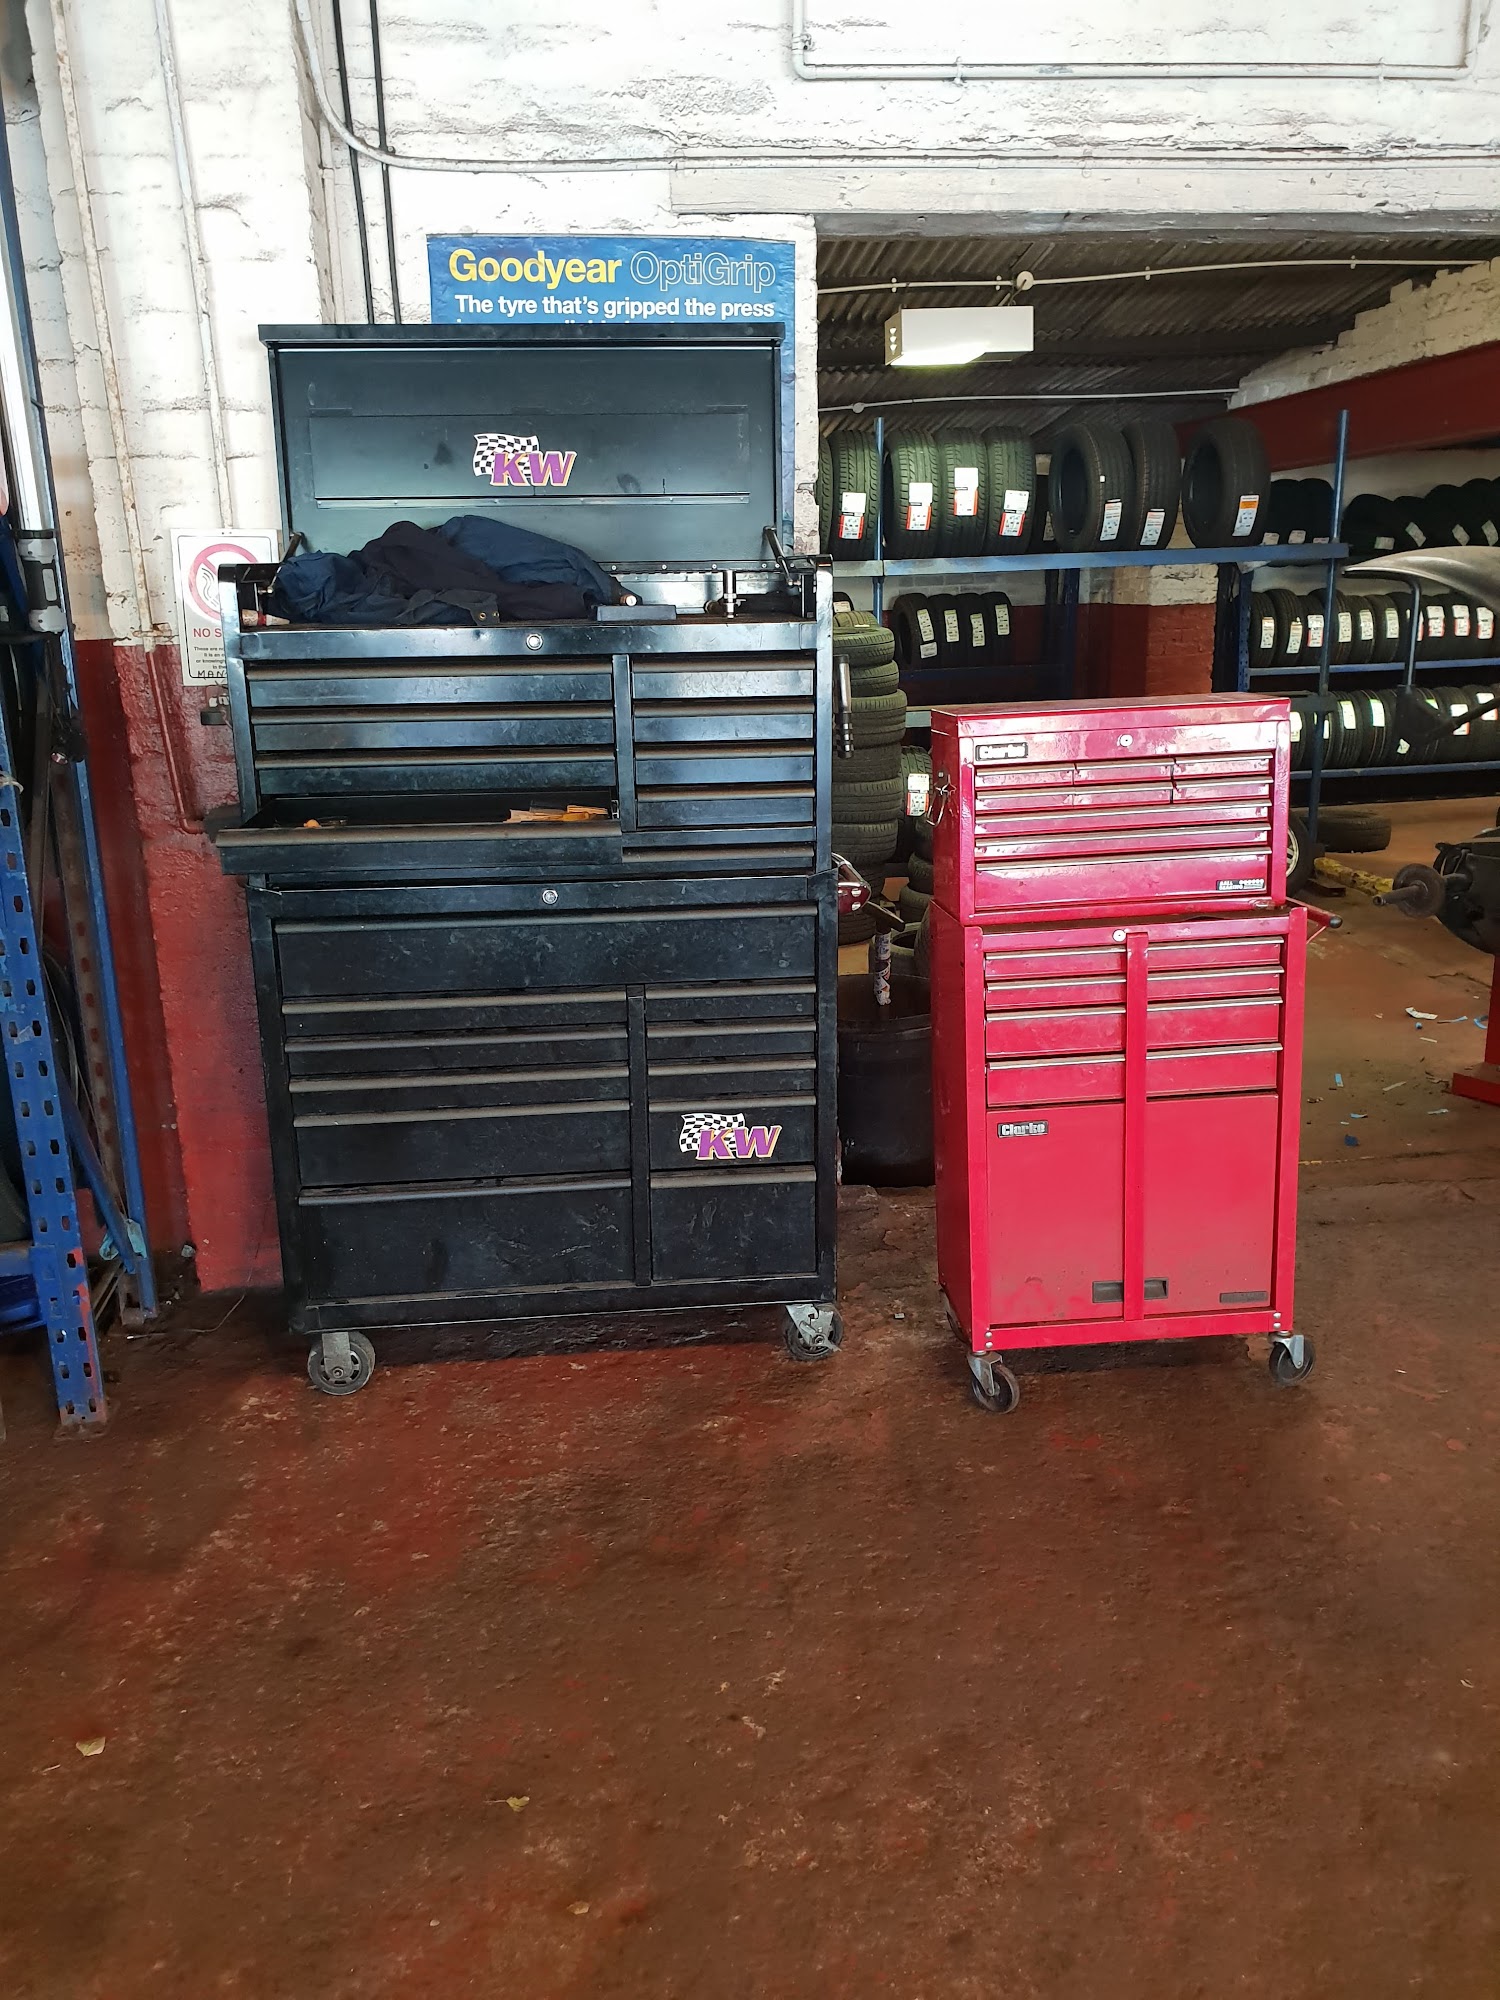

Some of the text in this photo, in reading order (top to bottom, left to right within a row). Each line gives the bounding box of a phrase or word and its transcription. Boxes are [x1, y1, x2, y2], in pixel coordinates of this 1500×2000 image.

[449, 248, 776, 293] Goodyear OptiGrip
[454, 294, 775, 320] The tyre that's gripped the press
[490, 450, 577, 486] KW
[193, 628, 210, 637] NO
[197, 670, 227, 678] MAN
[1001, 1122, 1046, 1136] Clarke
[696, 1125, 782, 1160] KW
